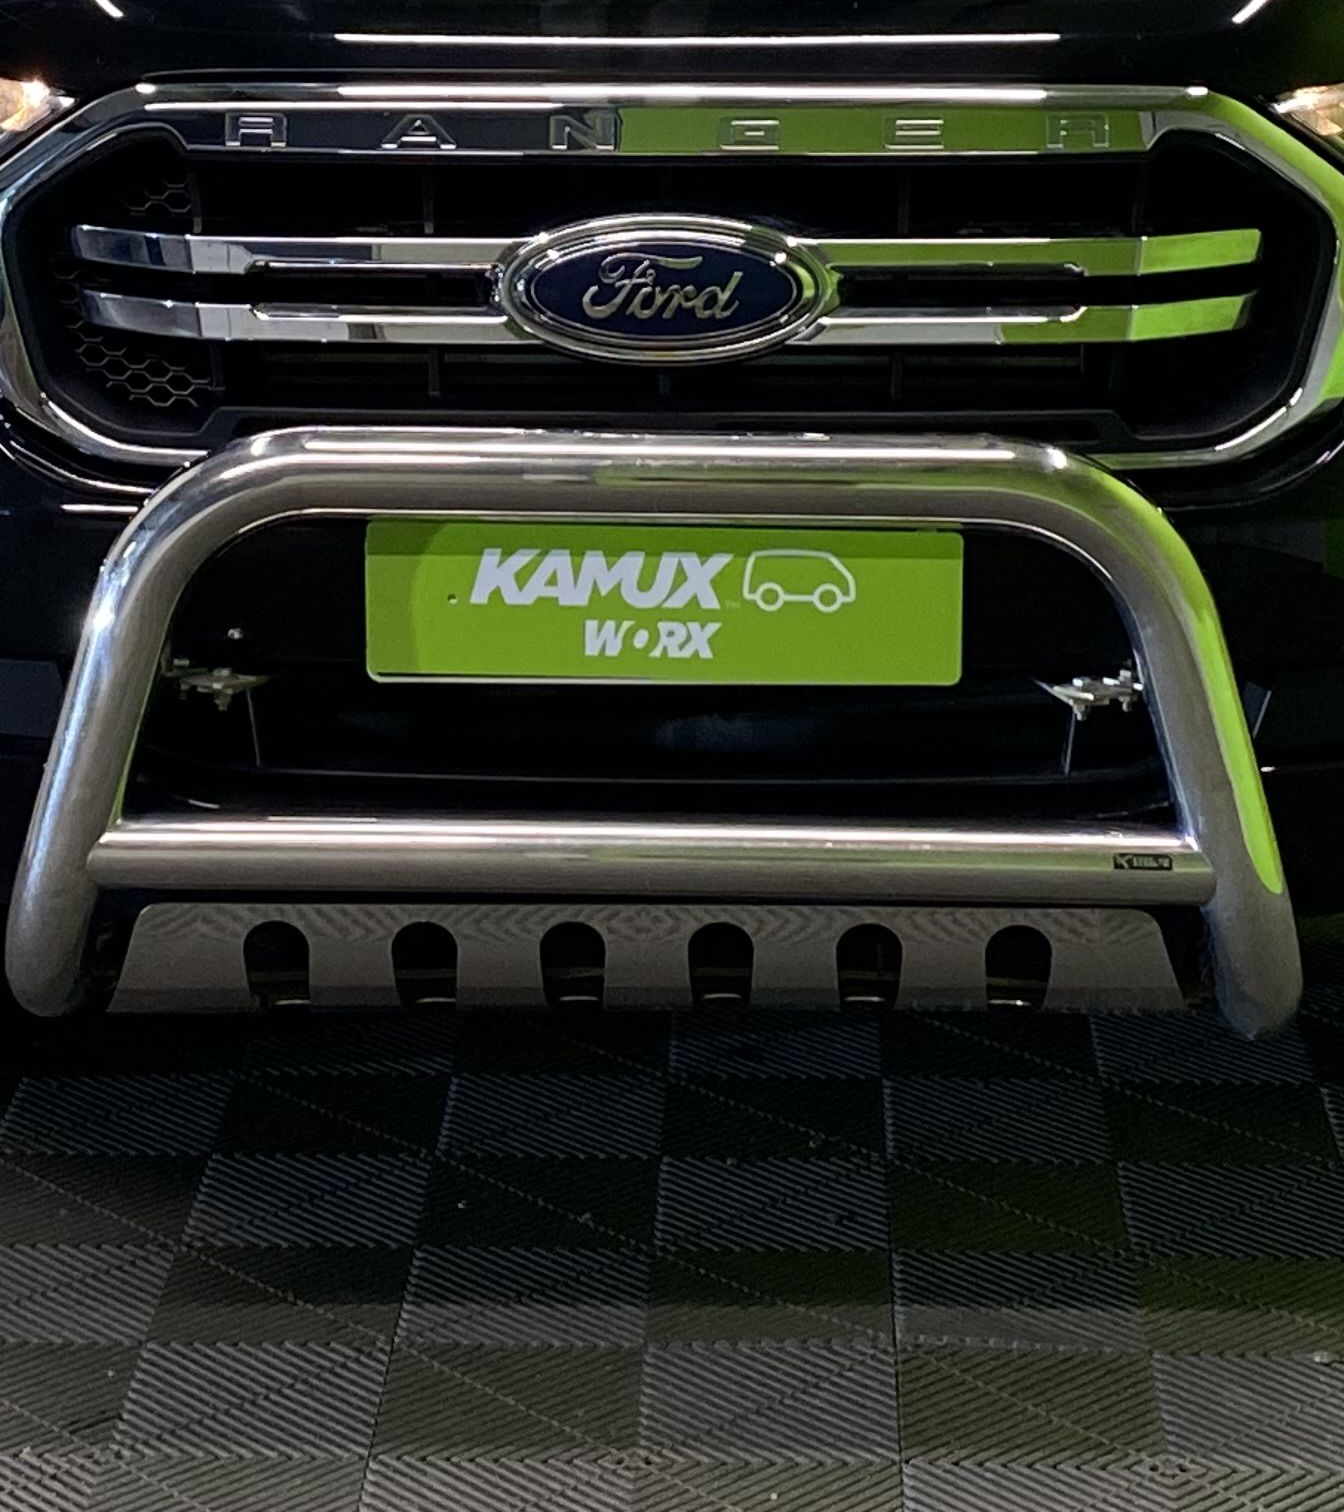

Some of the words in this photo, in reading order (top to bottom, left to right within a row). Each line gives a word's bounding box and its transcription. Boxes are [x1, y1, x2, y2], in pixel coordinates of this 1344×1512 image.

[224, 110, 1110, 151] RANGER
[582, 252, 743, 320] Ford
[469, 548, 733, 610] KAMUX
